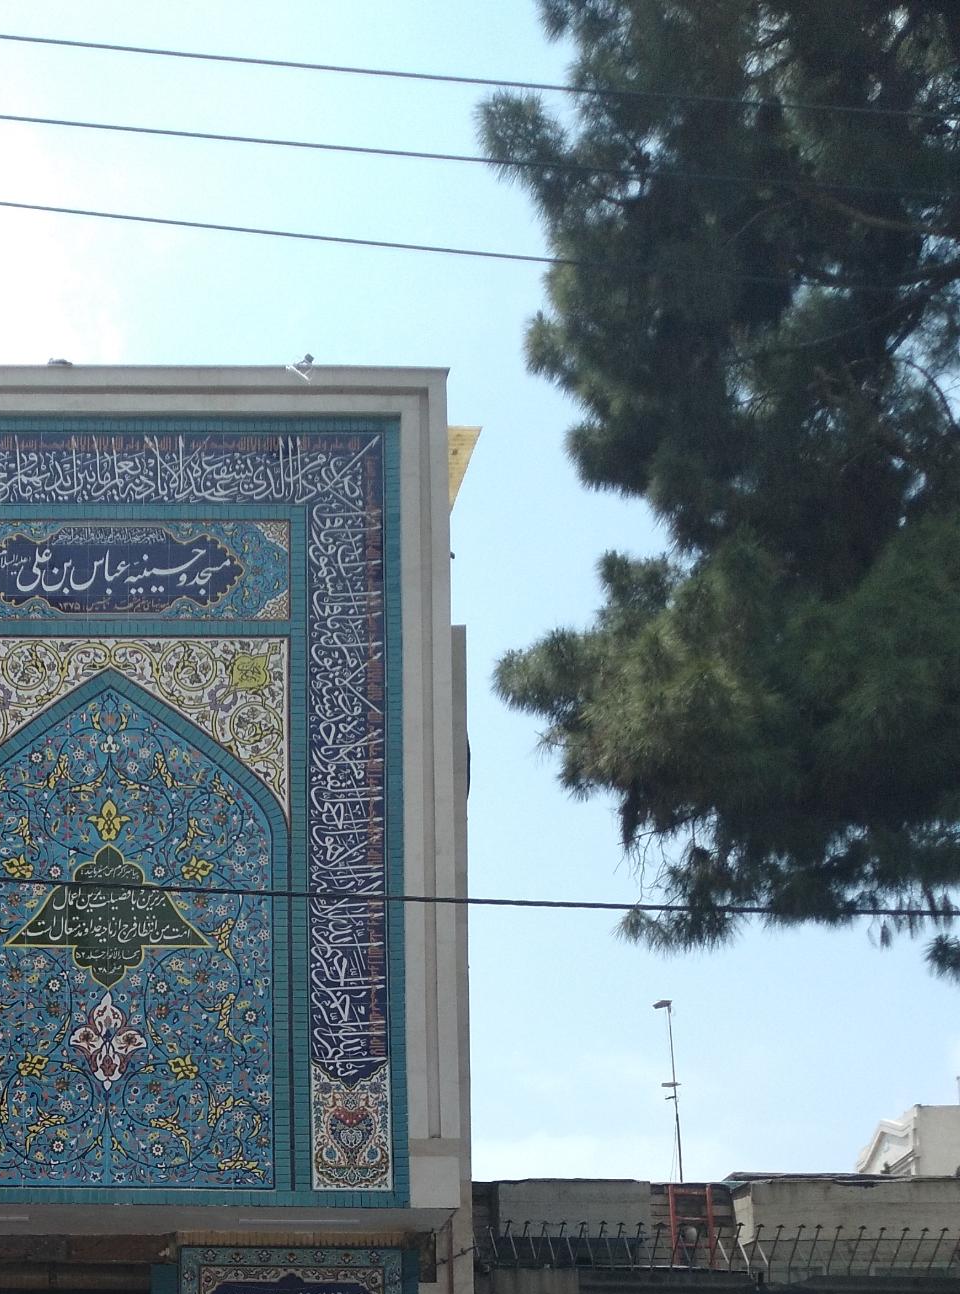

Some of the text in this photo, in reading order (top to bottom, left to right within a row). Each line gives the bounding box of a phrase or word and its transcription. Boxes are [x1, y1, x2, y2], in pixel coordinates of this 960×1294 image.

[16, 547, 53, 591] علی
[42, 559, 72, 594] بن
[70, 548, 130, 595] عباس
[176, 573, 187, 586] و
[185, 559, 230, 595] مسجد
[53, 887, 81, 910] اعمال
[49, 916, 81, 941] متعال
[117, 916, 136, 943] فرج
[149, 921, 170, 942] من
